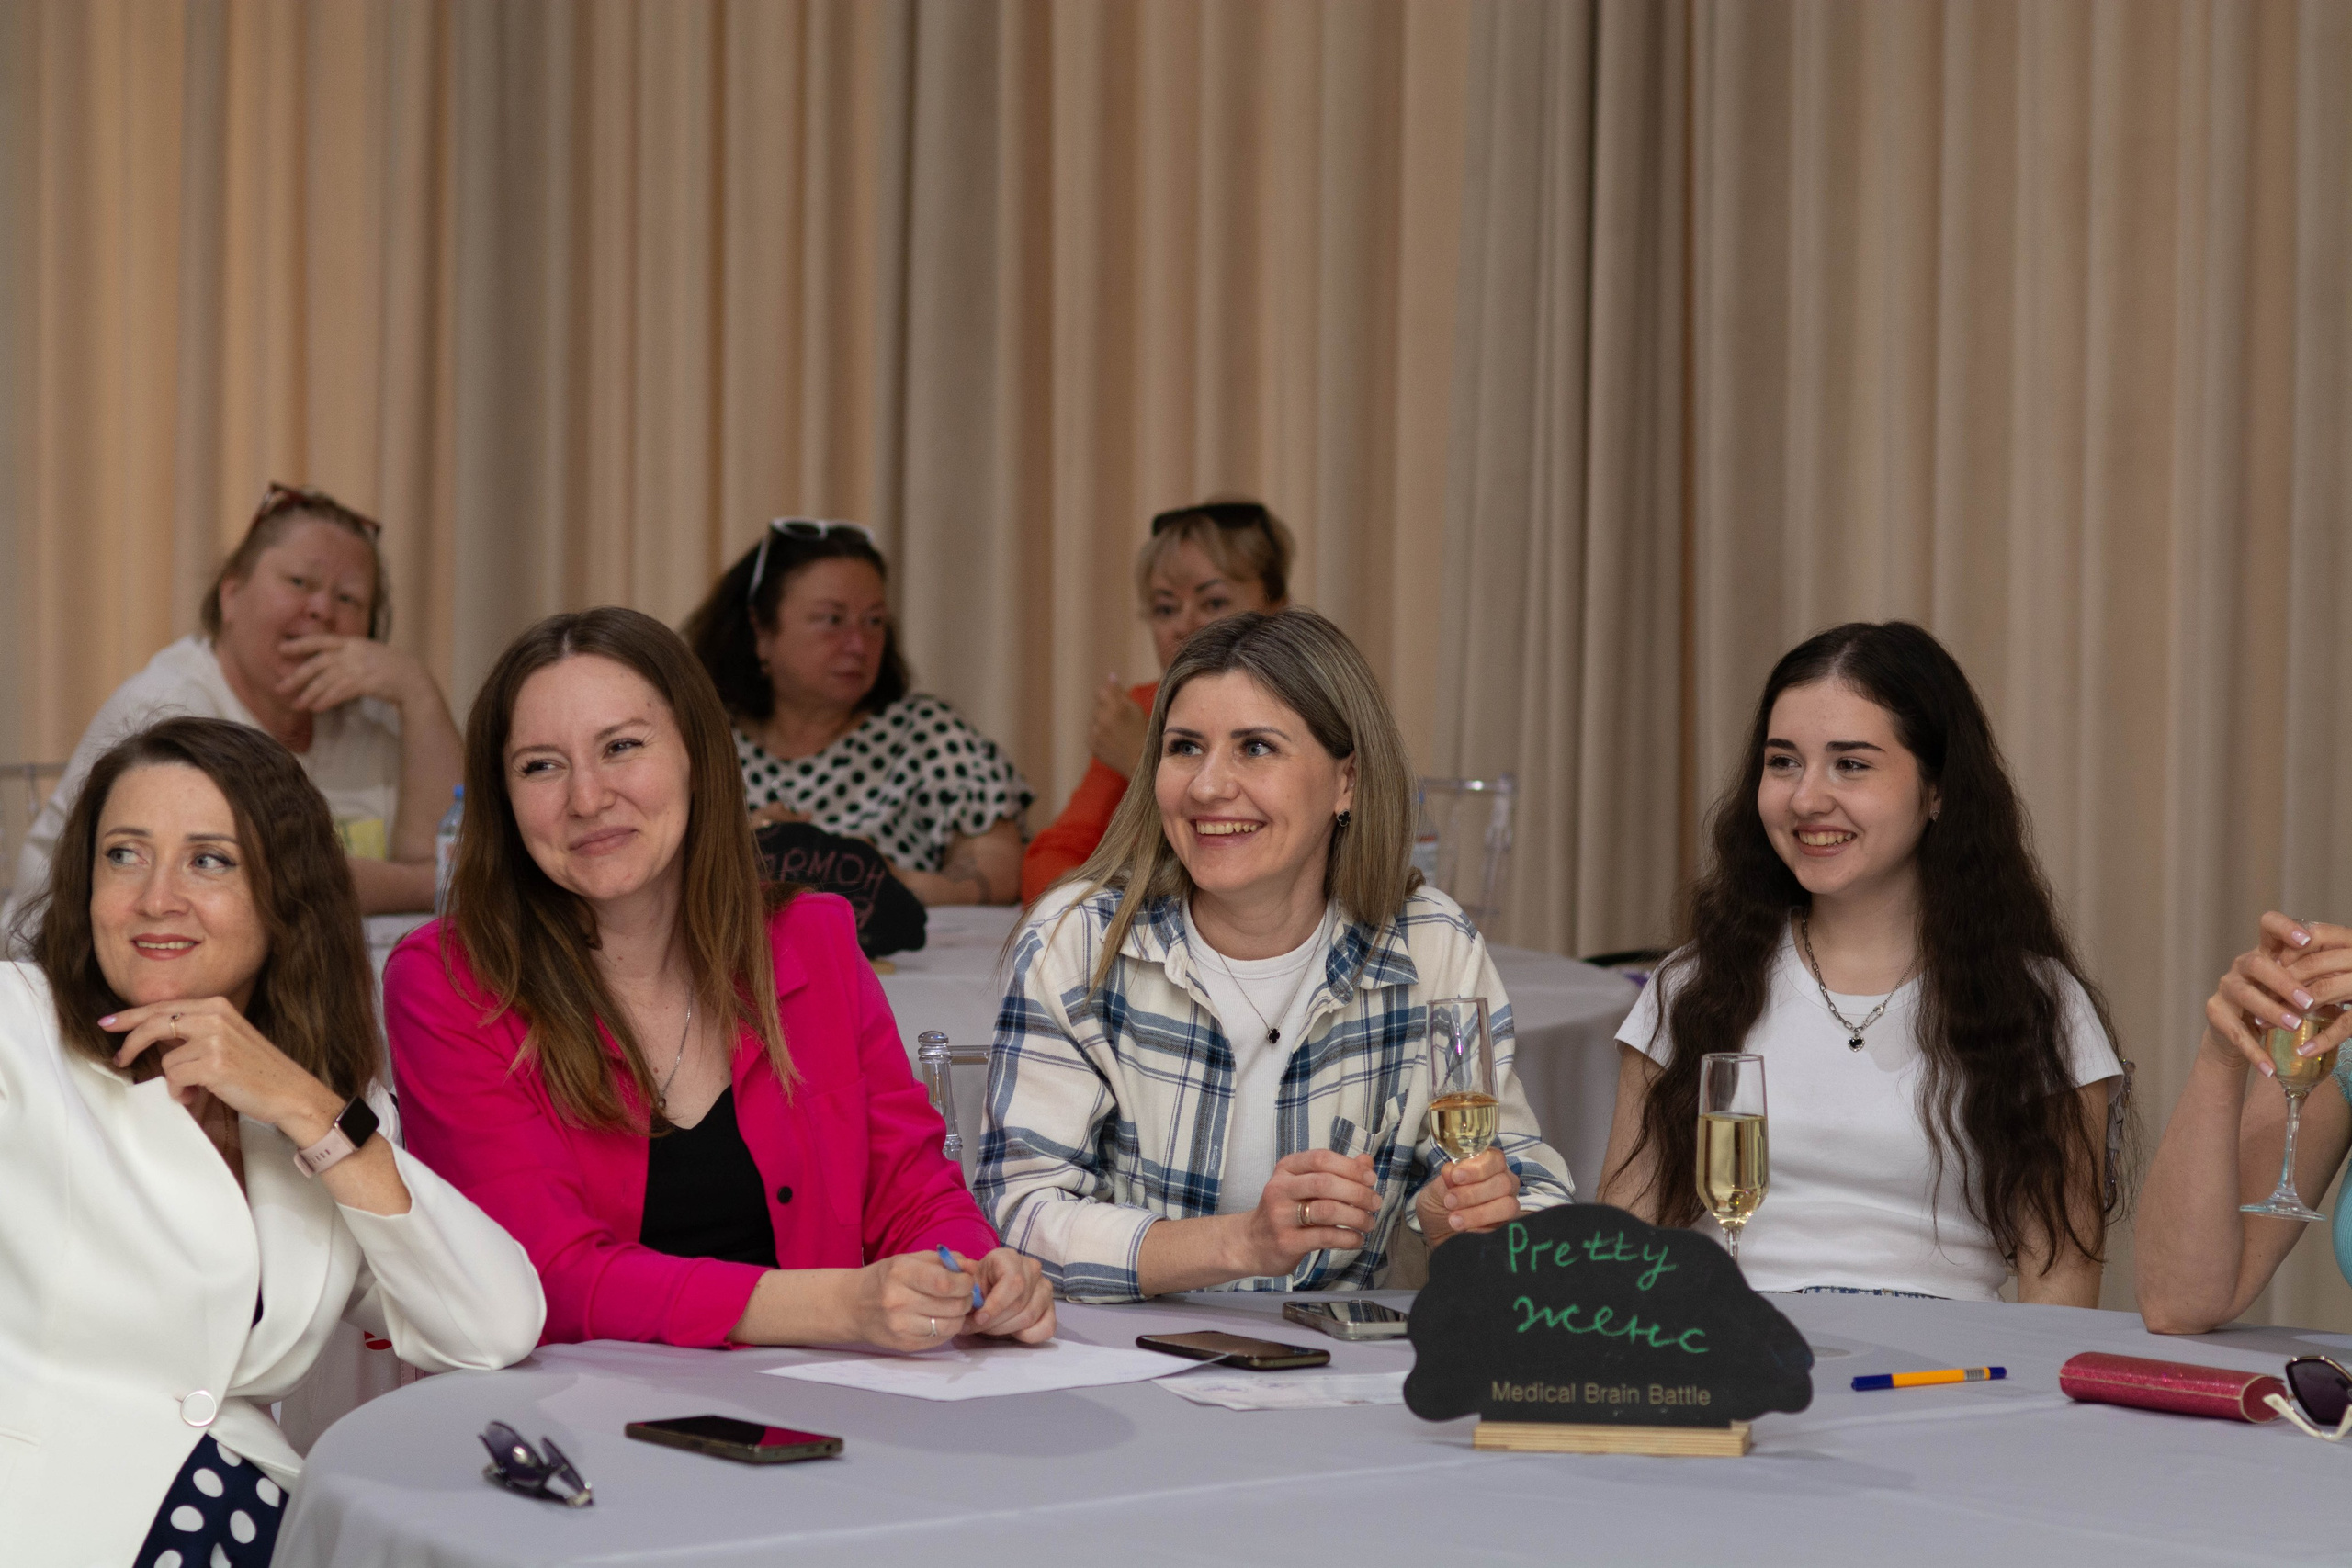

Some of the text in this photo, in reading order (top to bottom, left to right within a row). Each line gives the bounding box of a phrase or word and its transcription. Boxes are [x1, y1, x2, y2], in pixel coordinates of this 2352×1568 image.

[1508, 1223, 1679, 1291] Pretty
[1491, 1381, 1712, 1406] Medical Brain Battle
